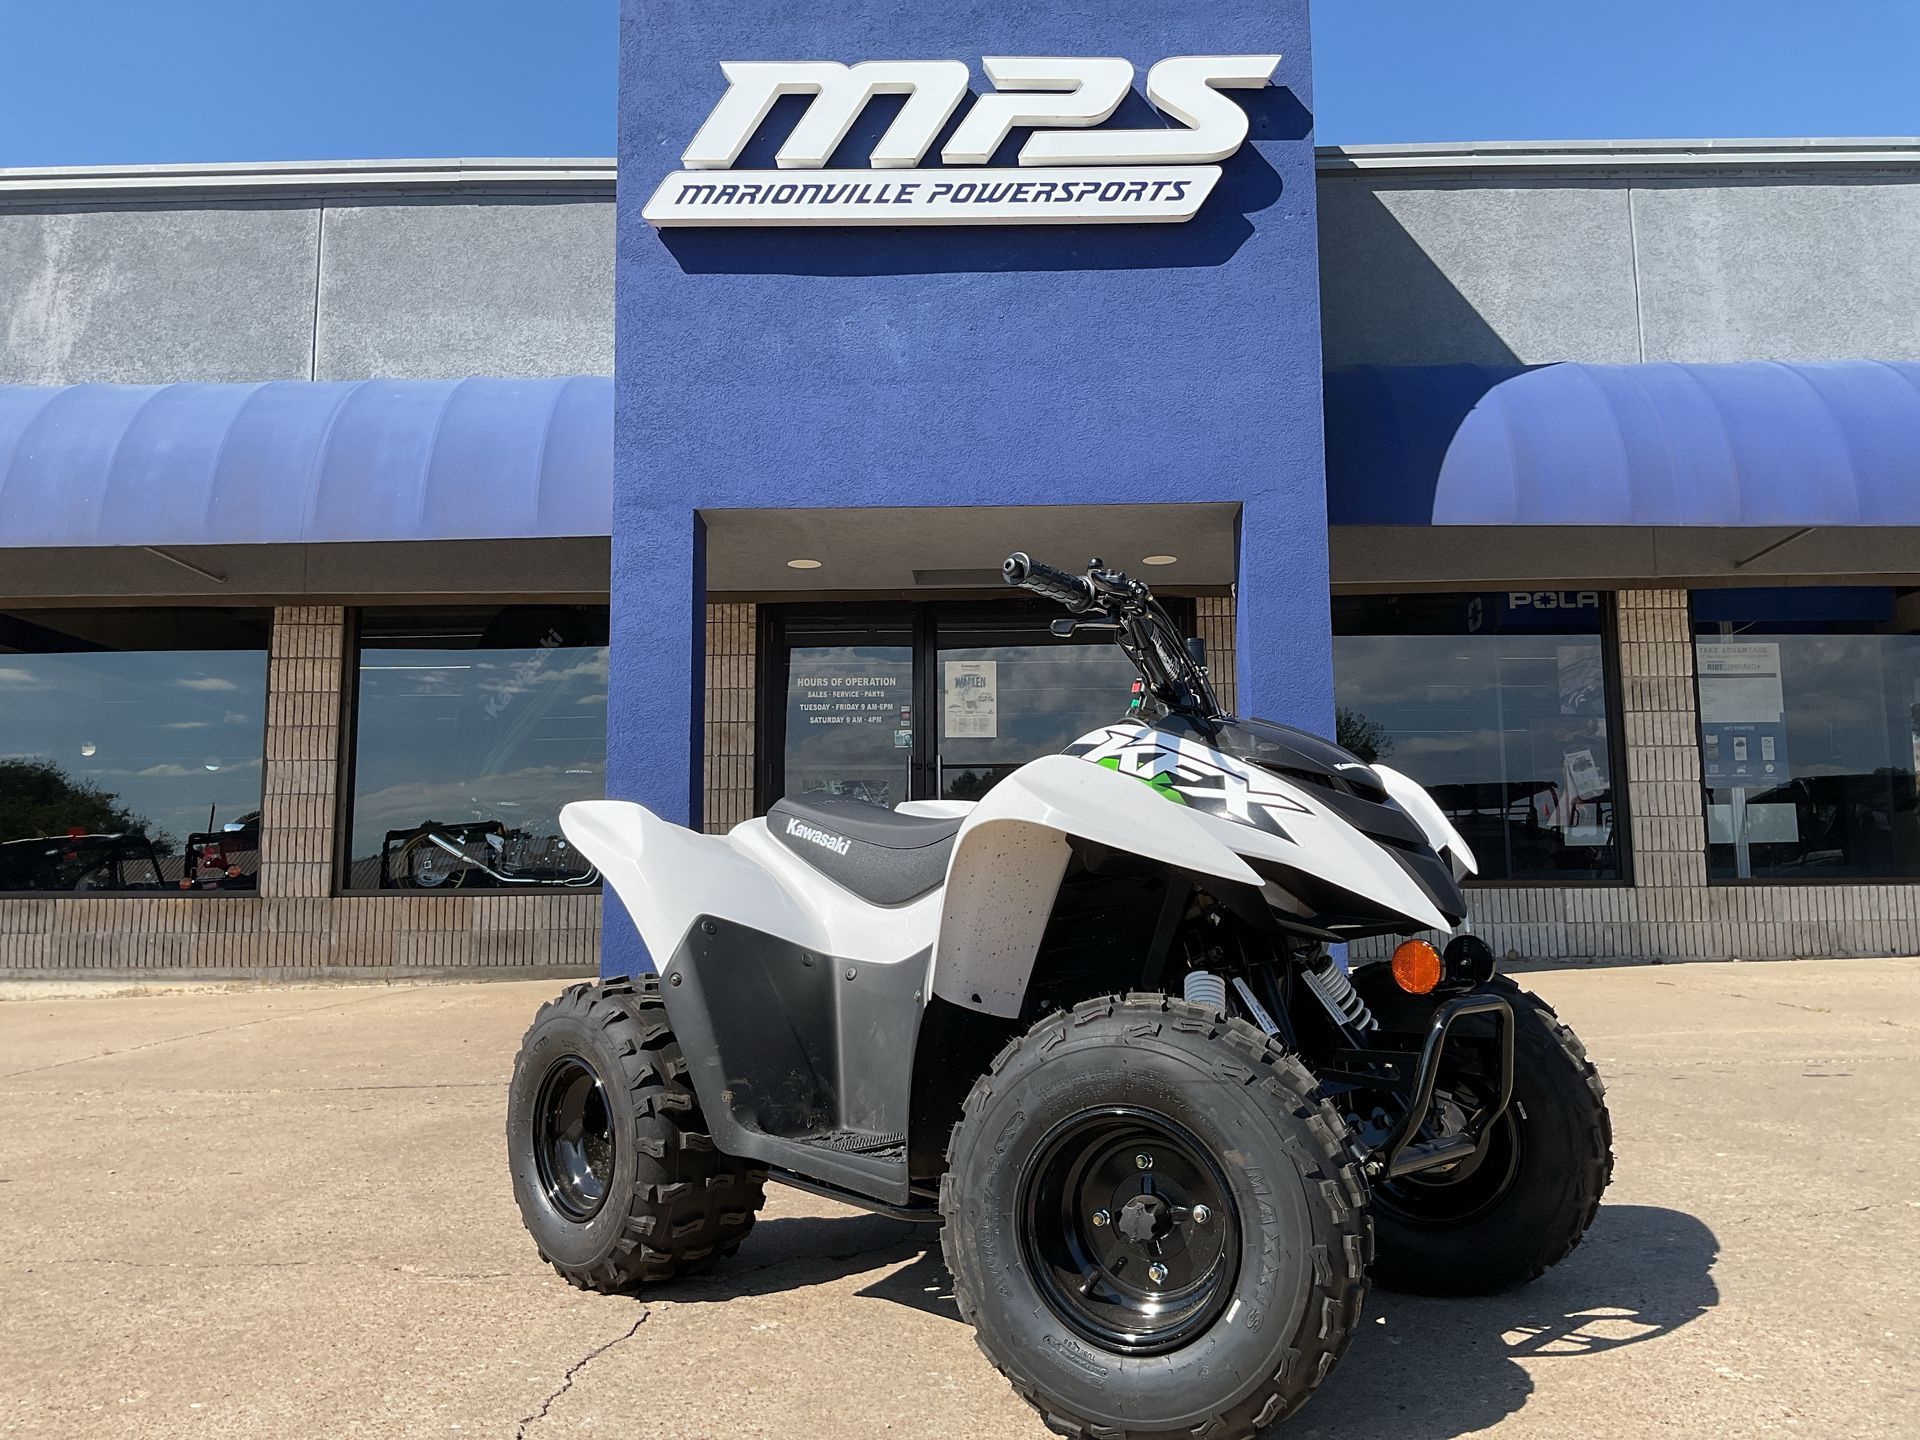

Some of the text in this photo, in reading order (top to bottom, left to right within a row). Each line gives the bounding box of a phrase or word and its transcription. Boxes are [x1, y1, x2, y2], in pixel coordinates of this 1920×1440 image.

[681, 55, 1282, 169] MPS
[674, 180, 1193, 205] MARIONVILLE POWERSPORTS
[1509, 592, 1599, 609] POLA
[1722, 646, 1768, 654] ADVANTAGE
[797, 677, 896, 687] HOURS OF OPERATION
[836, 703, 860, 711] FRIDAY
[786, 818, 852, 856] Kawasaki
[1243, 1166, 1281, 1334] MAXXIS
